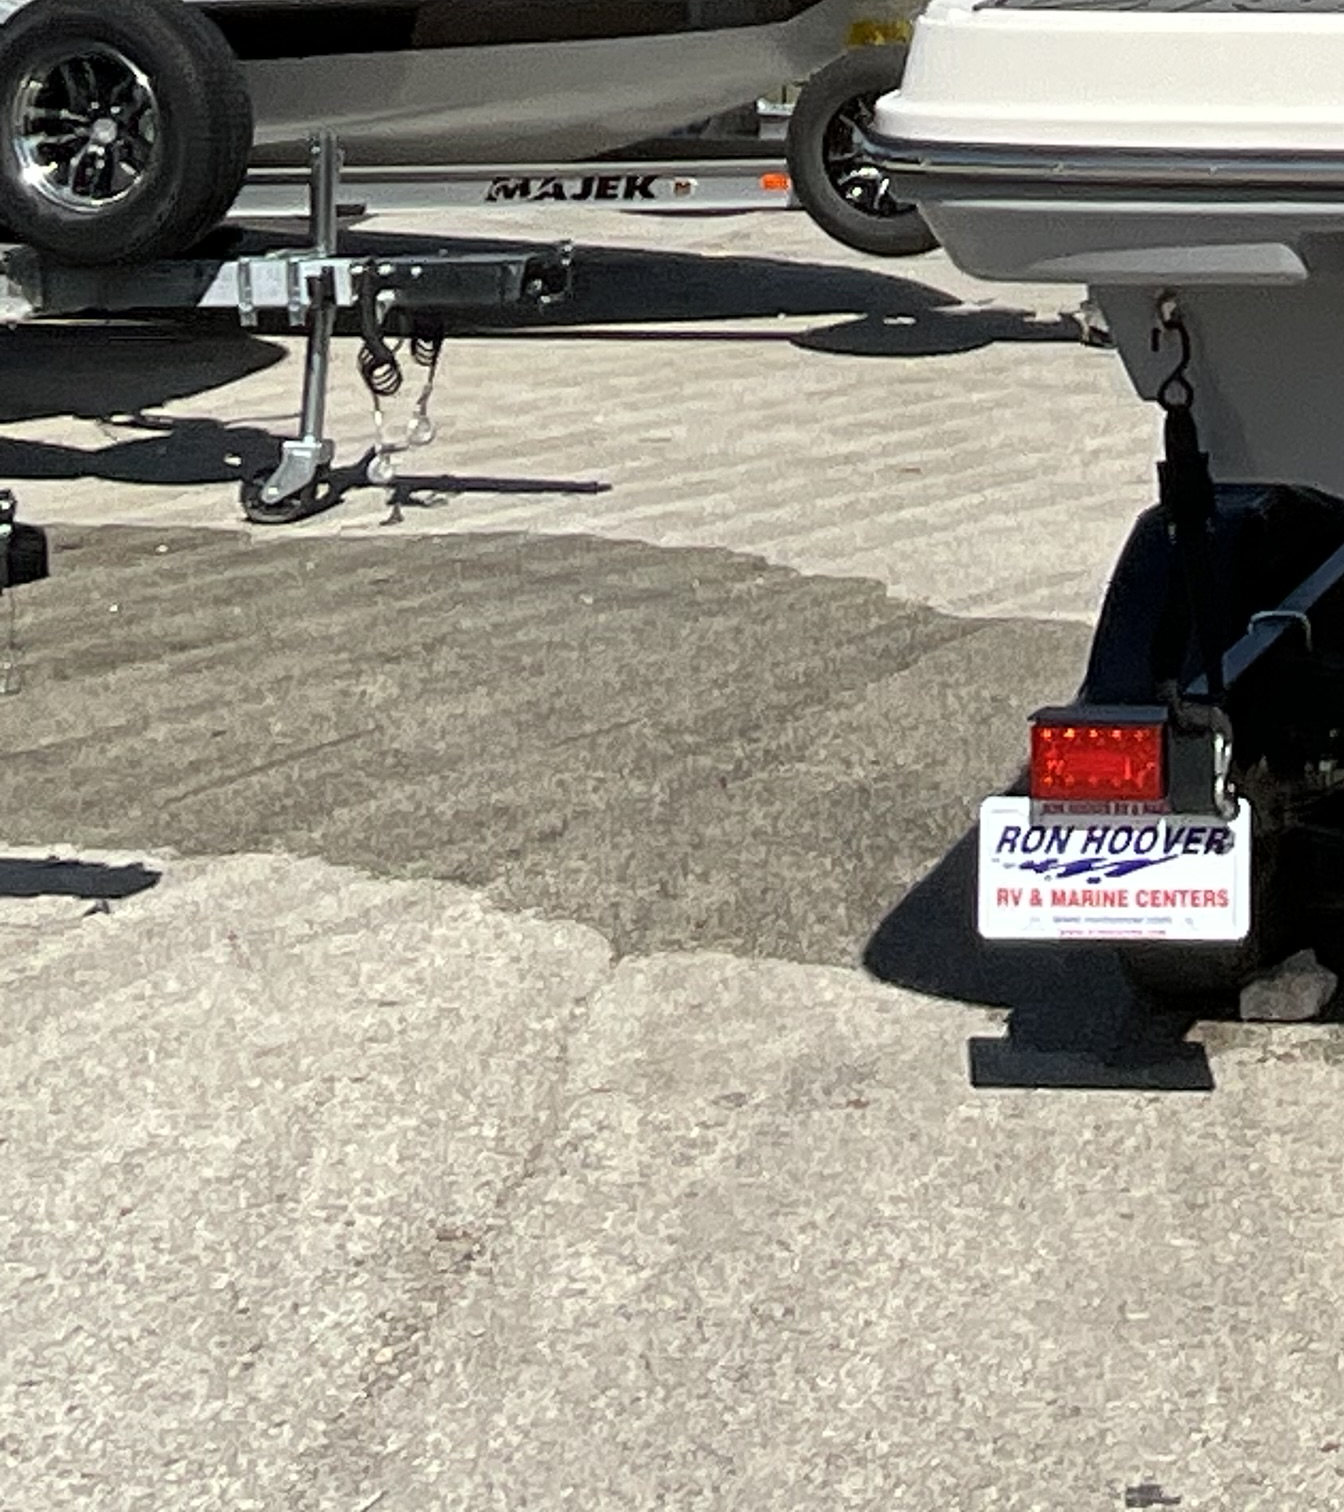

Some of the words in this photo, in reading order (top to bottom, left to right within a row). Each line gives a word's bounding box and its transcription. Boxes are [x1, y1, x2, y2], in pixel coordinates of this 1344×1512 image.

[485, 175, 658, 202] MAJEK
[995, 825, 1075, 854] RON
[1081, 825, 1232, 855] HOOVER
[996, 888, 1023, 907] RV
[1029, 889, 1043, 907] &
[1050, 889, 1129, 908] MARINE
[1135, 889, 1230, 908] CENTERS
